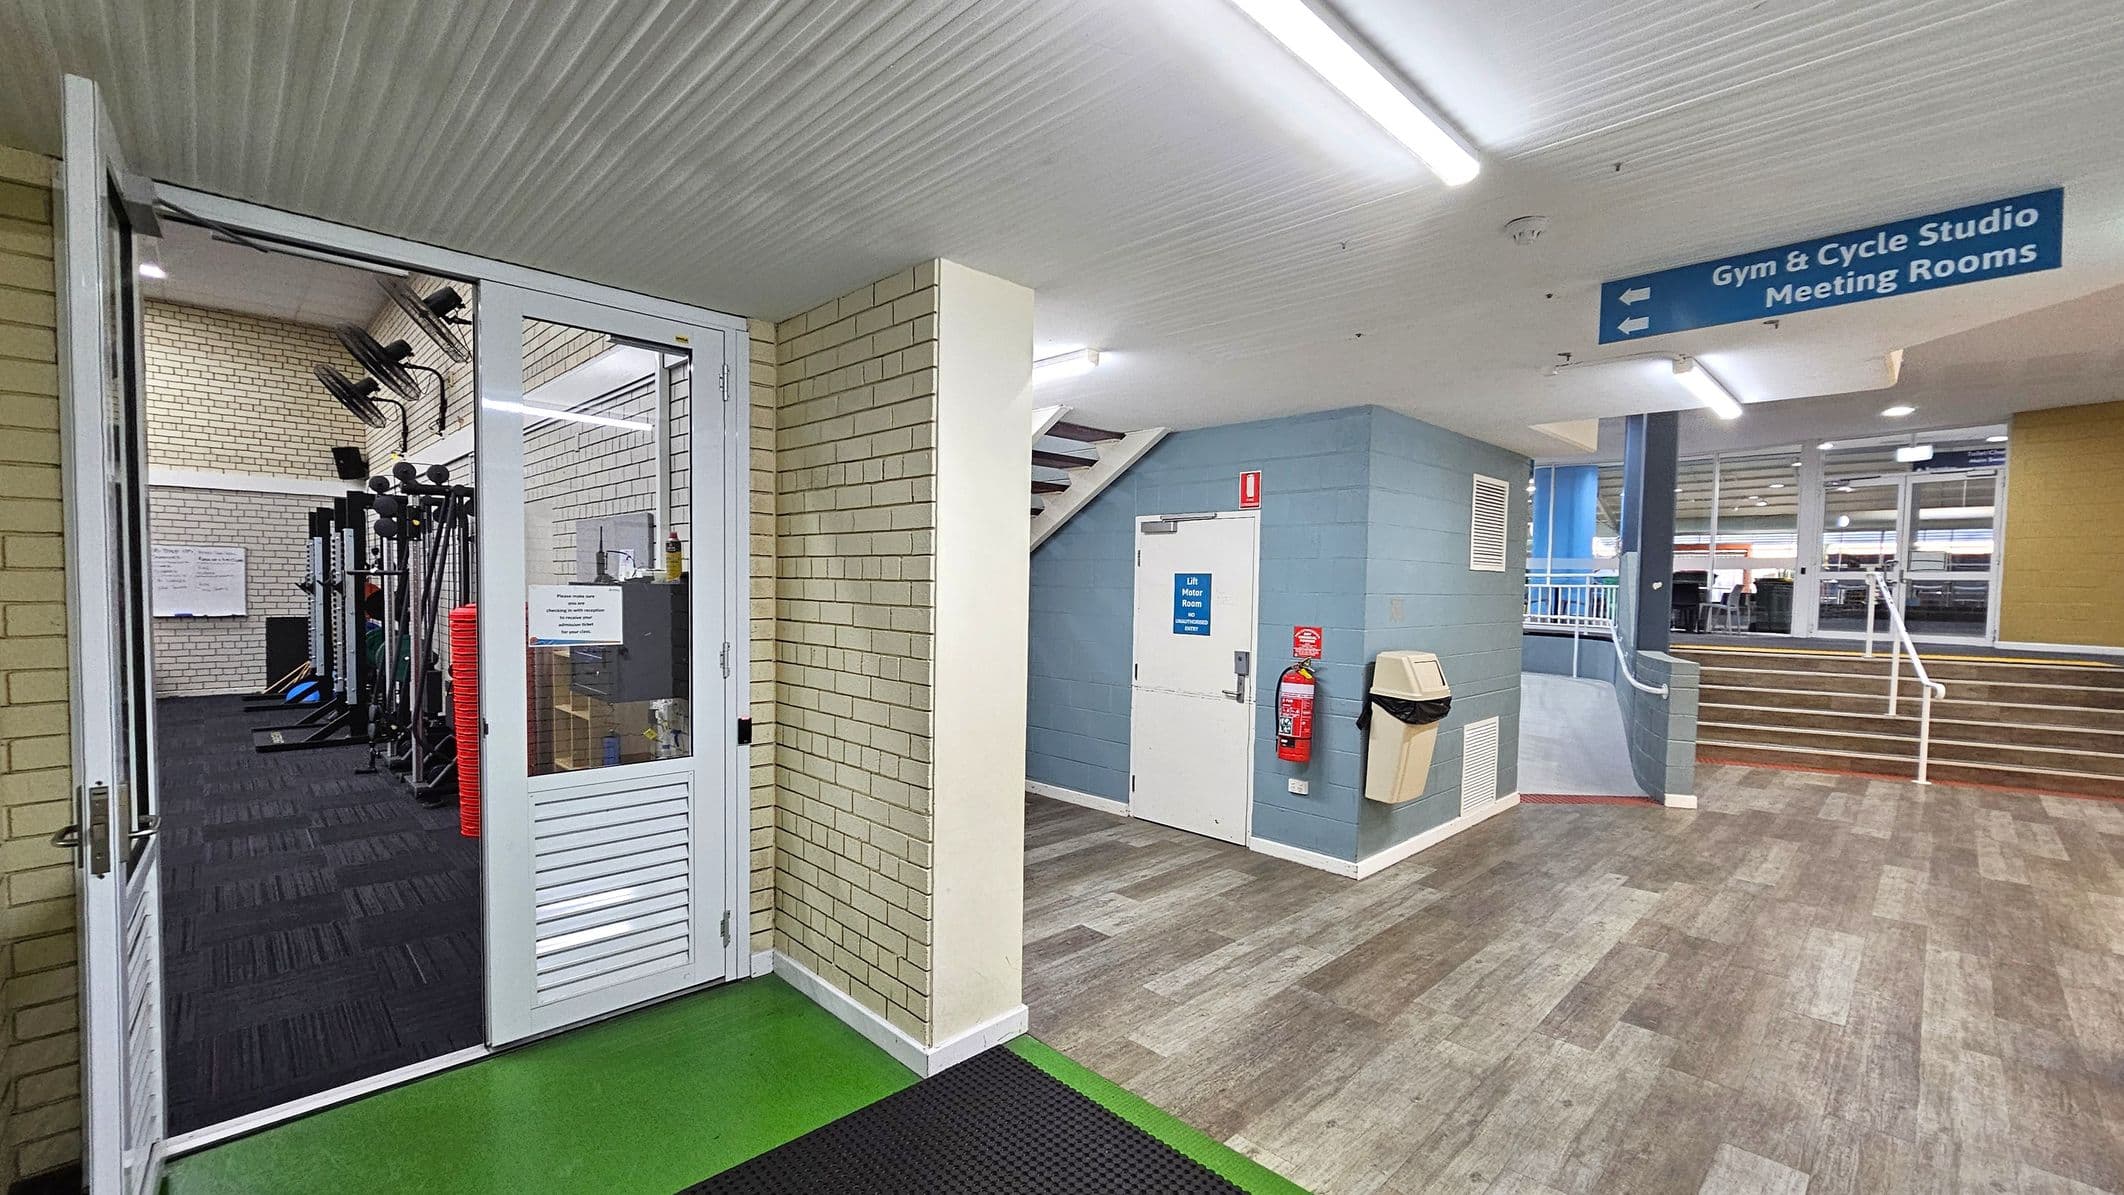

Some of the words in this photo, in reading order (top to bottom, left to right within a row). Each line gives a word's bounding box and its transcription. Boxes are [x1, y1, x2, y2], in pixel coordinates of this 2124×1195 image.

[1712, 259, 1776, 289] Gym
[1785, 250, 1809, 272] &
[1817, 229, 1908, 268] Cycle
[1918, 204, 2039, 248] Studio
[1765, 265, 1899, 308] Meeting
[1908, 243, 2038, 284] Rooms
[1186, 577, 1198, 586] Lift
[1182, 588, 1203, 597] Motor
[1182, 599, 1202, 608] Room
